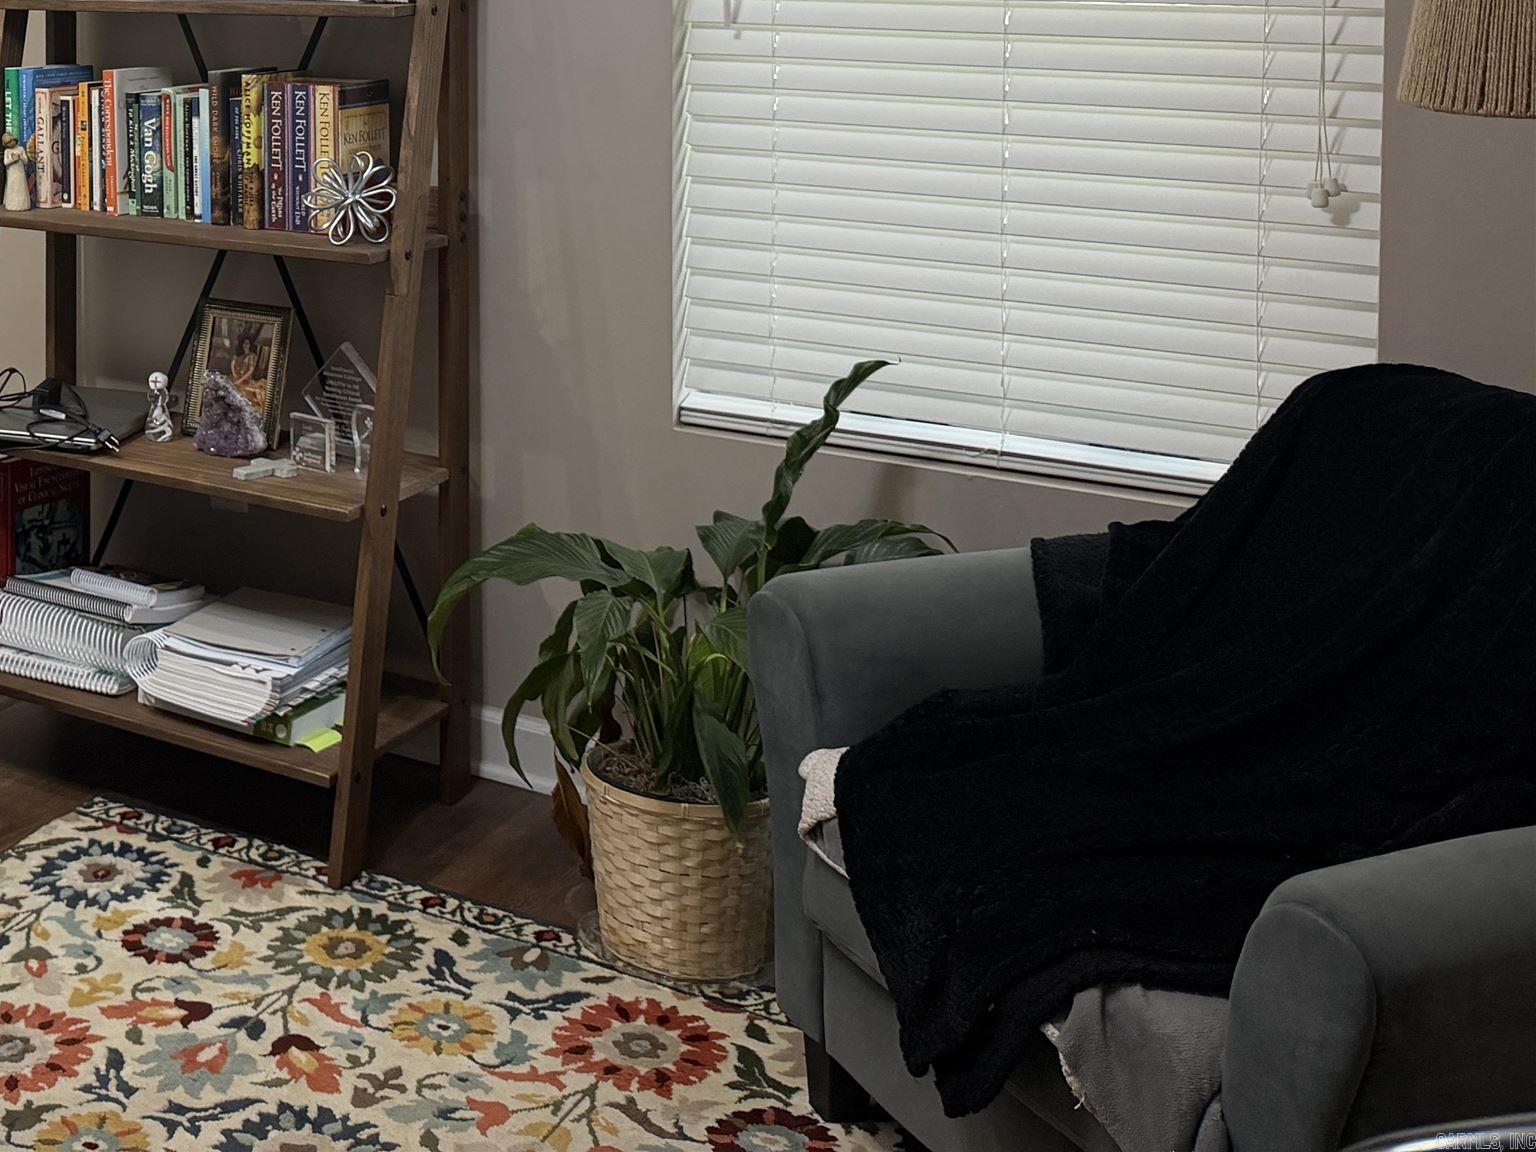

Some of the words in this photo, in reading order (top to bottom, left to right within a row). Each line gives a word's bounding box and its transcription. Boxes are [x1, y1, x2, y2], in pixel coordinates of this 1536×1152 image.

[104, 79, 112, 97] The
[271, 92, 282, 116] KEN
[295, 92, 306, 116] KEN
[318, 92, 330, 116] KEN
[104, 99, 113, 166] Correspondent
[144, 118, 156, 147] Van
[244, 114, 253, 165] HOFFMAN
[271, 120, 282, 171] FOLLETT
[296, 120, 306, 172] FOLLETT
[320, 122, 331, 170] FOLLET
[344, 132, 358, 146] KEN
[358, 128, 385, 144] FOLLETT
[142, 150, 157, 193] Gogh
